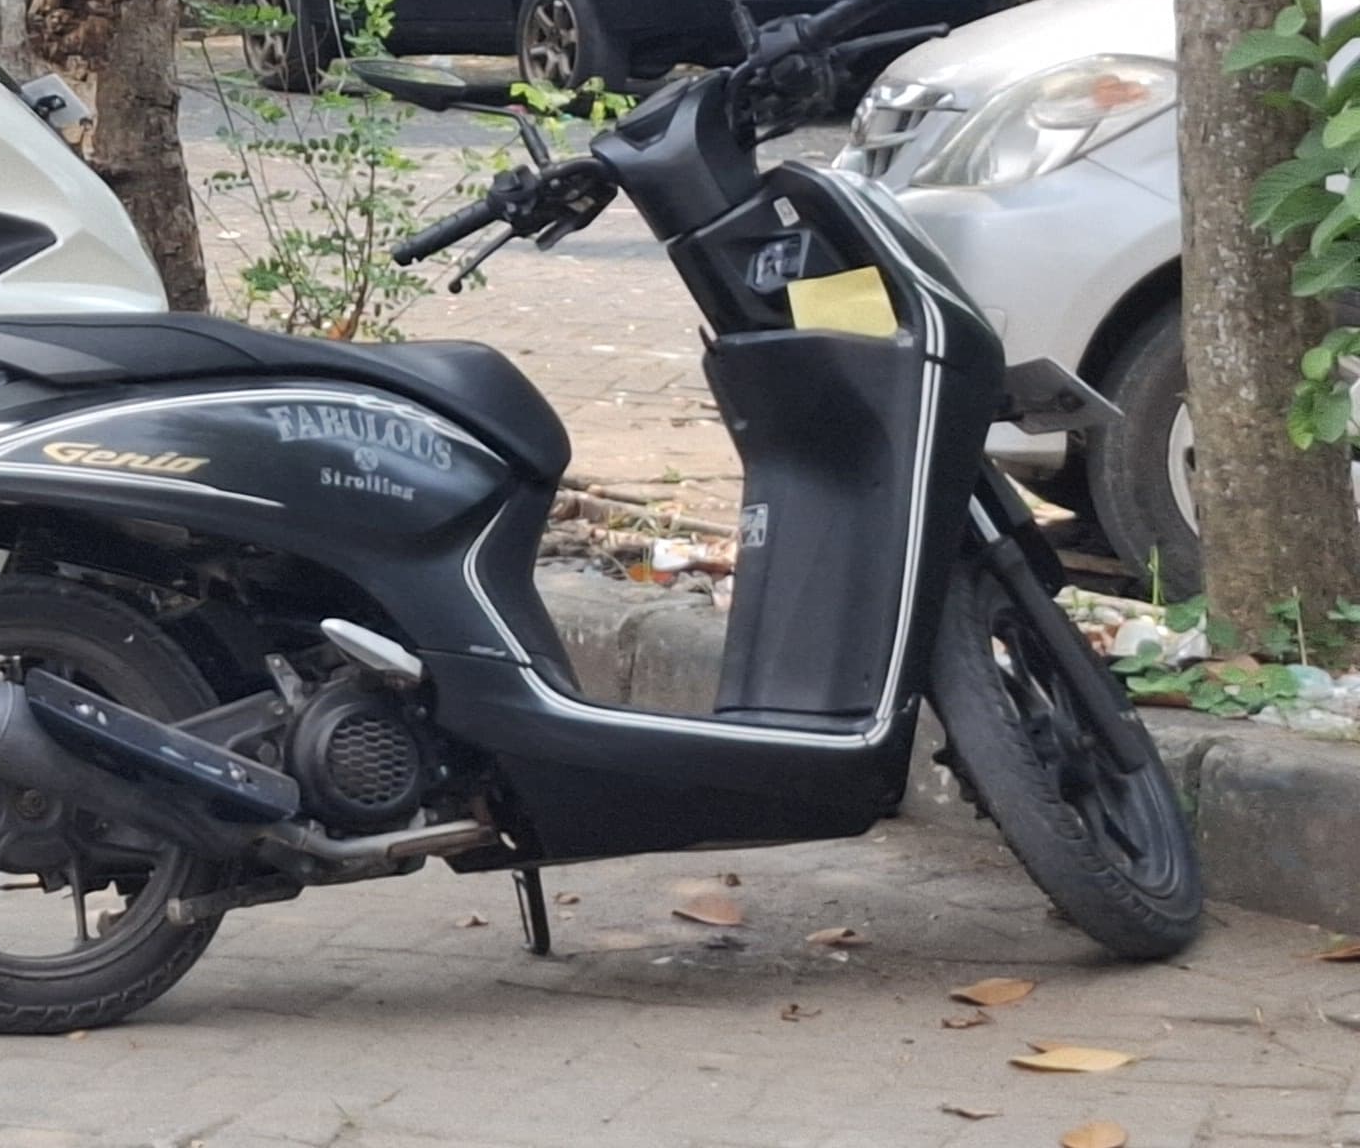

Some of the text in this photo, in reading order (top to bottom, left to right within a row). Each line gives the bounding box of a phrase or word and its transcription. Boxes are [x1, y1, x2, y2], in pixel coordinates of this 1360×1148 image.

[267, 405, 453, 471] FABULOUS
[42, 441, 212, 474] Genio
[320, 467, 417, 501] Strolling
